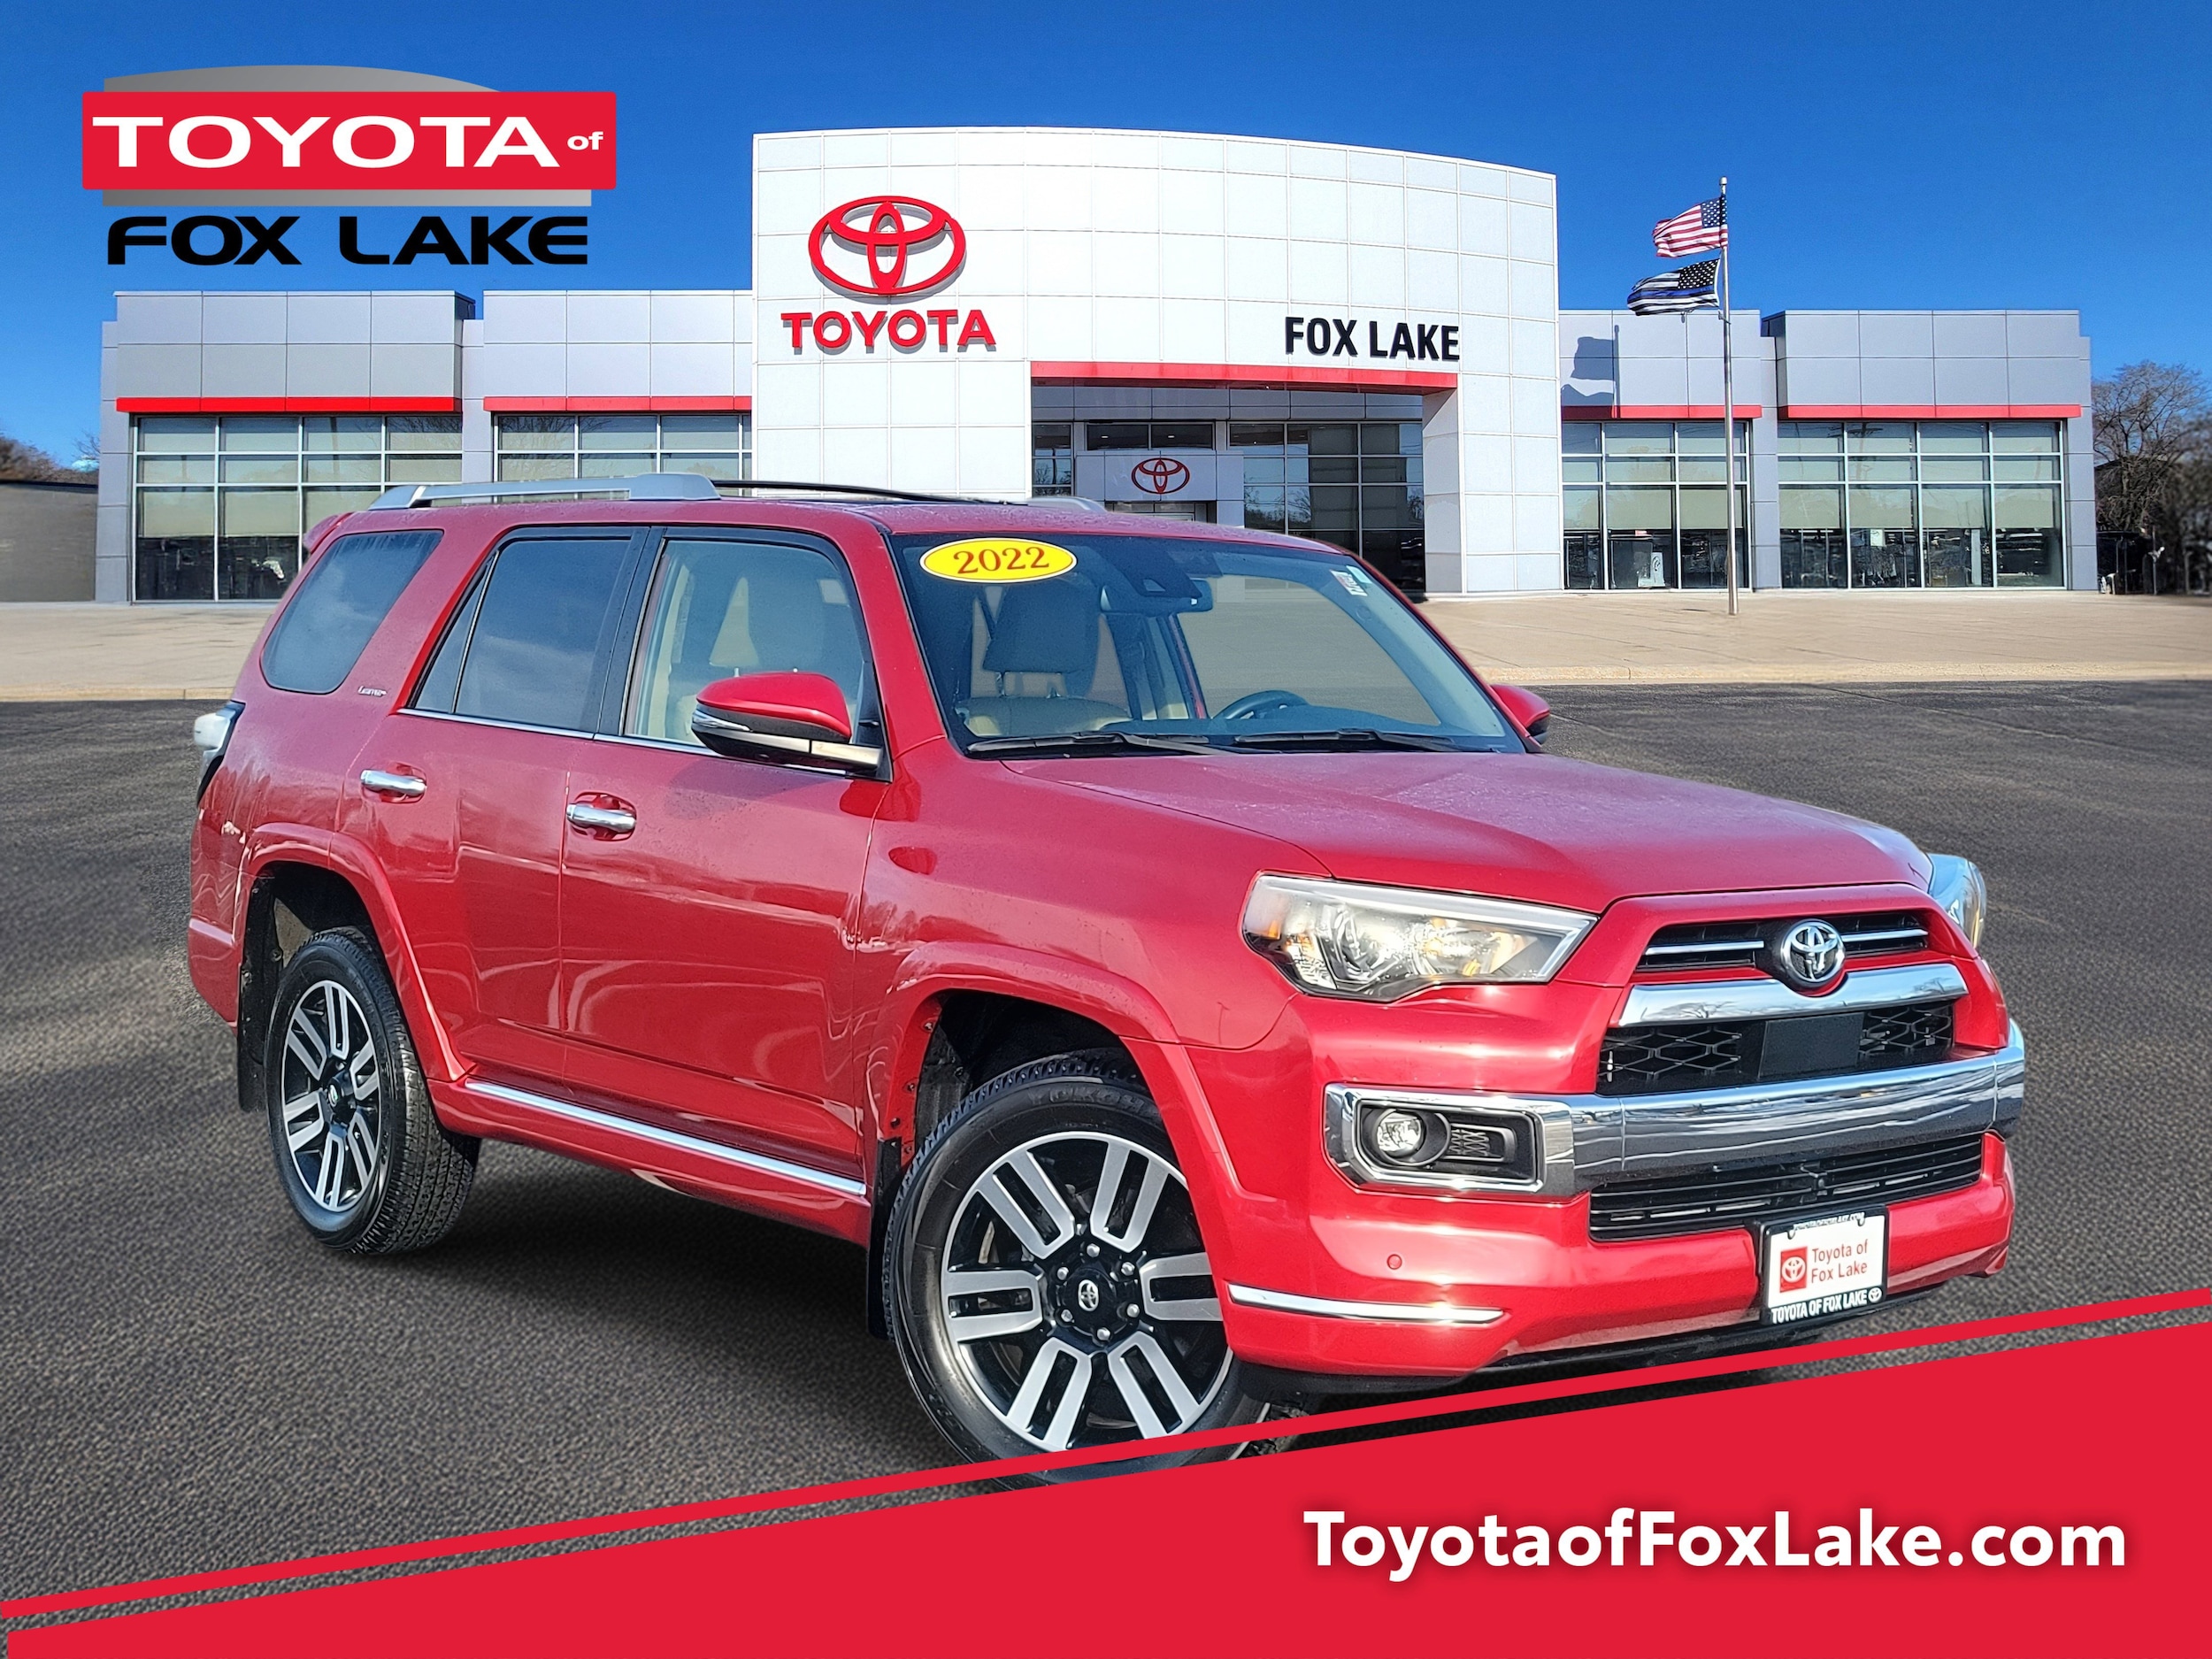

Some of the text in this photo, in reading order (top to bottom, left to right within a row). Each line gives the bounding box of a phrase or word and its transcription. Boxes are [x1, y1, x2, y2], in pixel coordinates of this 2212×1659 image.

[780, 310, 996, 350] TOYOTA
[1285, 317, 1460, 361] FOX LAKE
[953, 546, 1049, 574] 2022
[1811, 1238, 1869, 1265] Toyota of
[1811, 1260, 1868, 1284] Fox Lake
[1771, 1288, 1869, 1325] TOYOTA OF FOX LAKE
